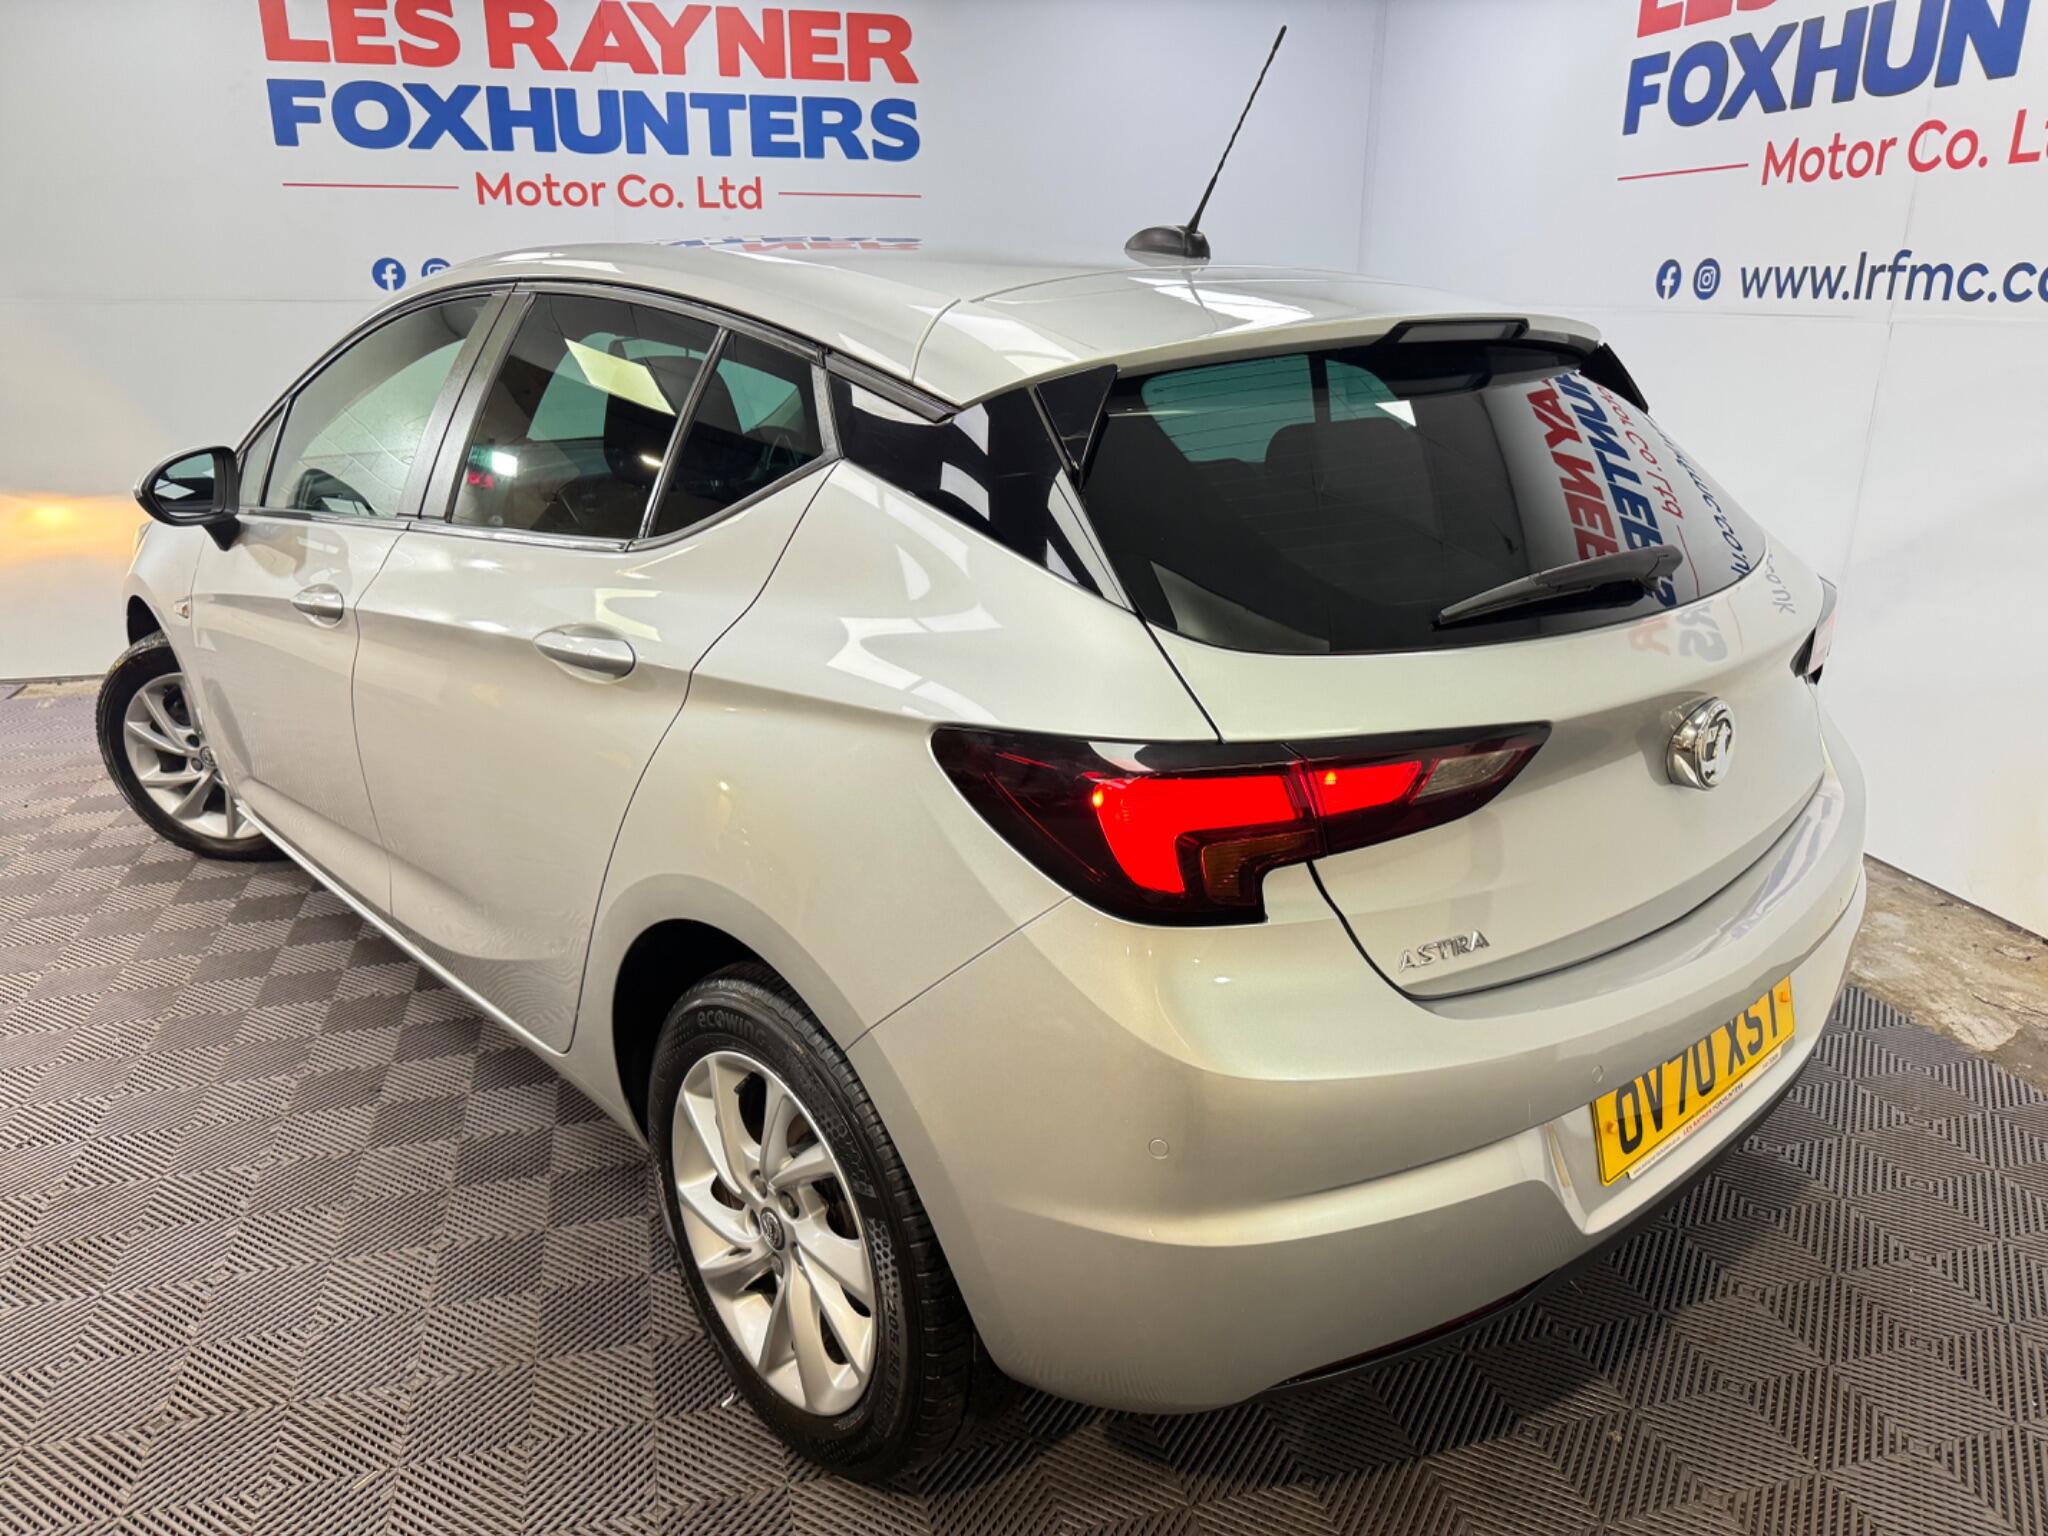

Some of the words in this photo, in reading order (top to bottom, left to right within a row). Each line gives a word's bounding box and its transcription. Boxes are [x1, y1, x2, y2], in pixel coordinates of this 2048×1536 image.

[258, 0, 461, 68] LES
[482, 0, 919, 84] RAYNER
[266, 79, 921, 162] FOXHUNTERS
[1761, 133, 1897, 186] Motor
[1907, 119, 1988, 173] Co.
[475, 171, 606, 208] Motor
[617, 174, 685, 209] Co.
[697, 176, 763, 210] Ltd
[1400, 929, 1490, 972] ASTRA
